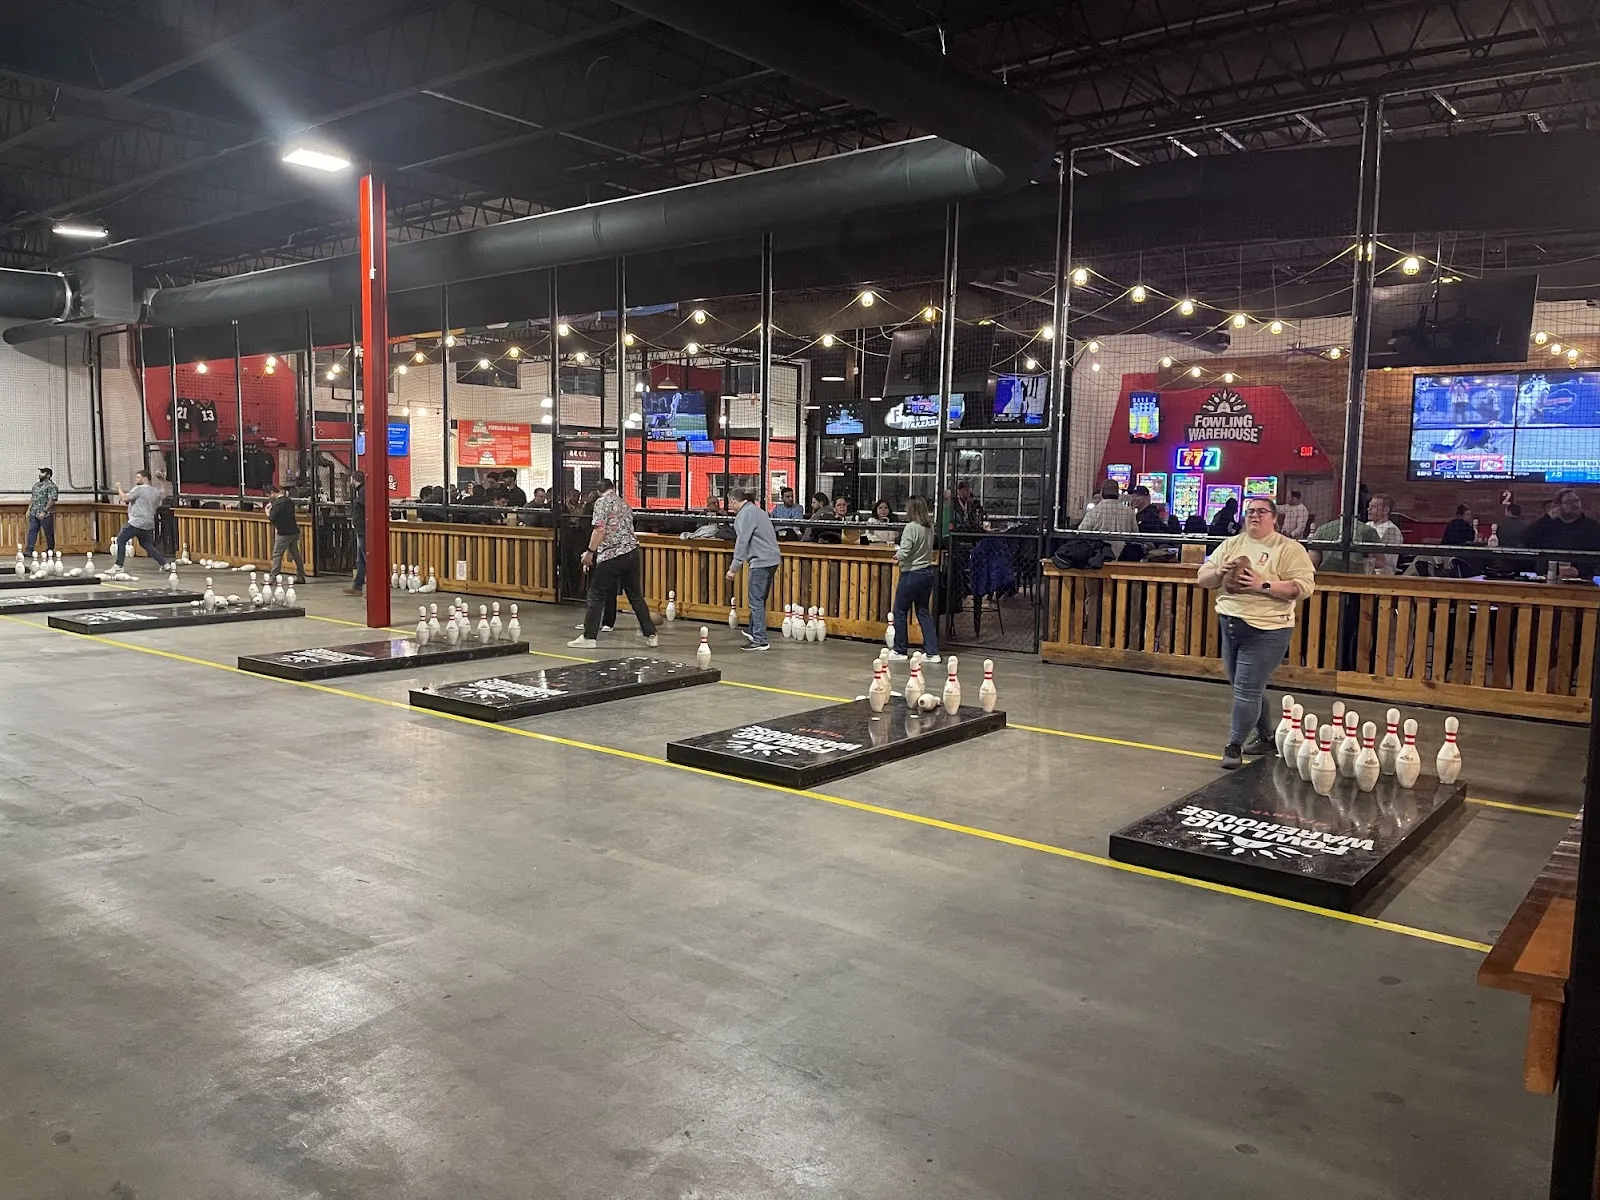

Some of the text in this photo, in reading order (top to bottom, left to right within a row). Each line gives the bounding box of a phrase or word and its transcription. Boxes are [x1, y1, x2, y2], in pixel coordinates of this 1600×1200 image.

[177, 406, 188, 420] 21
[201, 410, 215, 422] 13
[1194, 414, 1253, 428] FOWLING
[1188, 428, 1258, 442] WAREHOUSE
[1300, 446, 1313, 456] EXIT
[1183, 451, 1214, 466] 777
[1502, 490, 1512, 505] 2
[1176, 805, 1375, 851] WAREHOUSE
[1181, 816, 1350, 856] FOWLING
